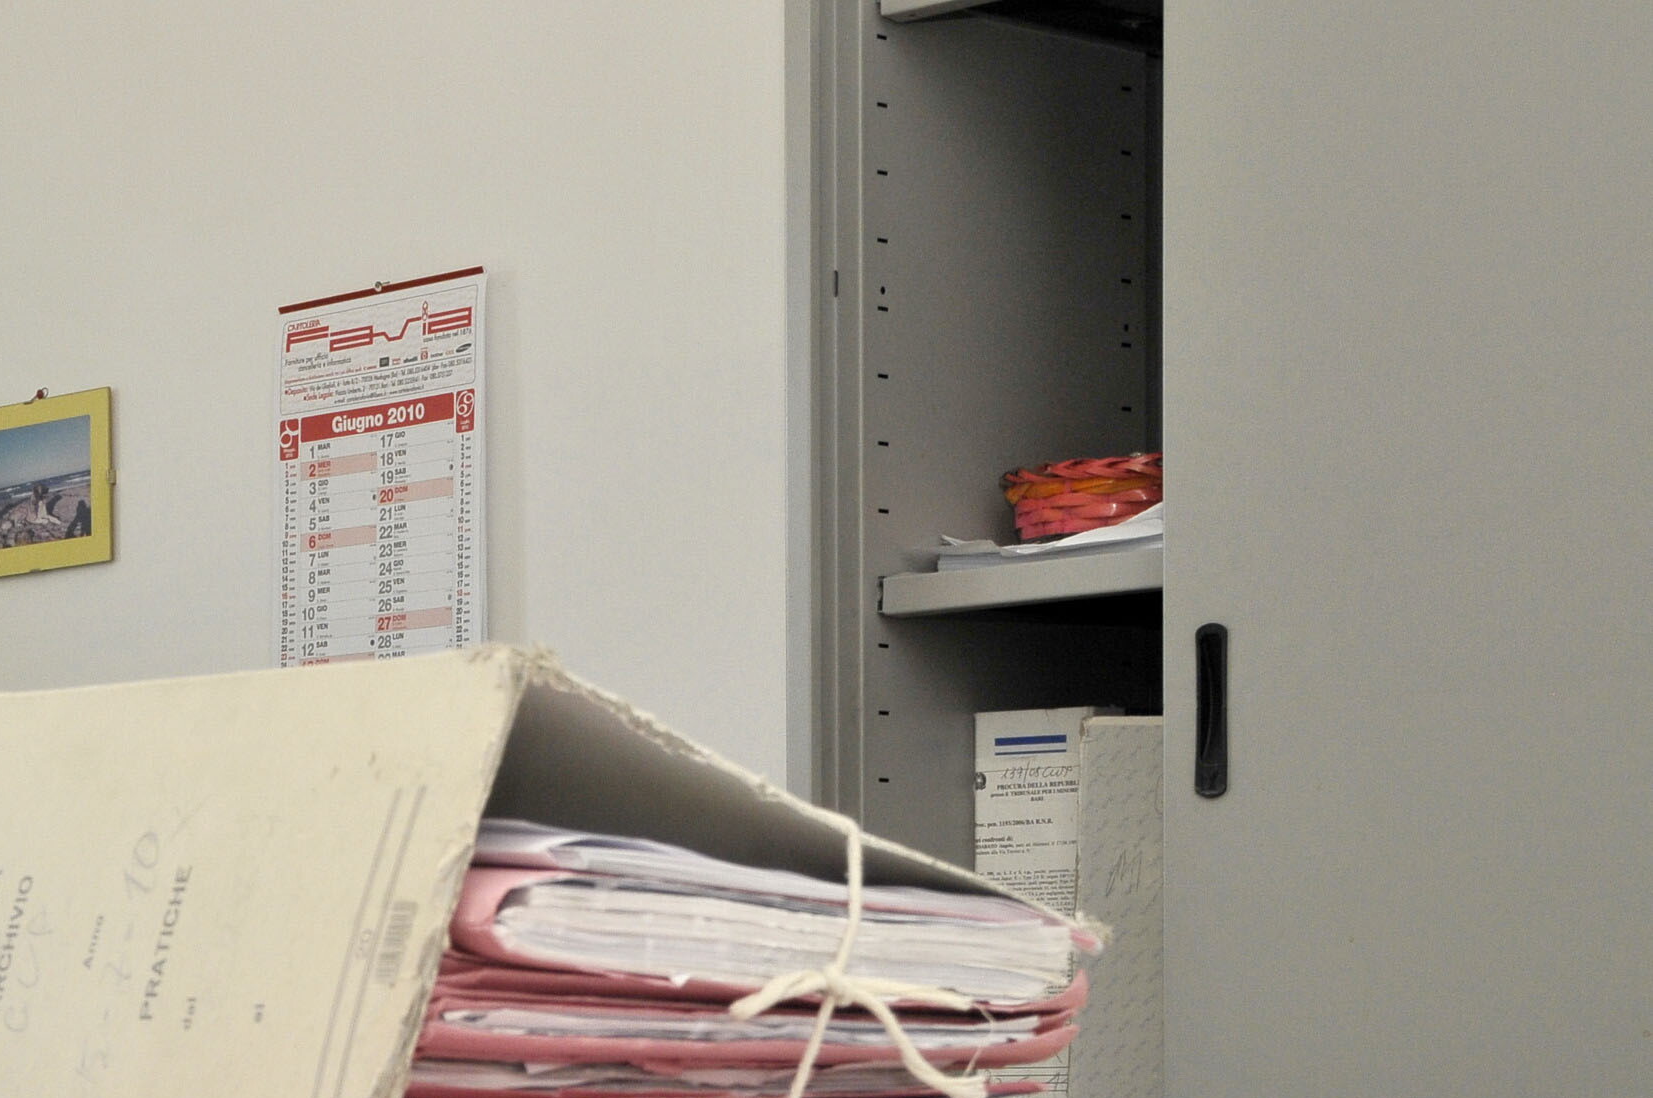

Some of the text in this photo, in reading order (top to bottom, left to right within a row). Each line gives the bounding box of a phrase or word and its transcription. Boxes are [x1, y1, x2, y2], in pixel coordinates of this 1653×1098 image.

[332, 403, 424, 432] Giugno 2010
[380, 434, 393, 448] 17
[310, 446, 315, 459] 1
[380, 452, 394, 466] 18
[309, 464, 316, 477] 2
[380, 470, 394, 484] 19
[309, 482, 316, 495] 3
[380, 489, 393, 503] 20
[309, 500, 316, 512] 4
[380, 507, 392, 521] 21
[309, 518, 316, 530] 5
[379, 526, 392, 539] 22
[309, 536, 316, 549] 6
[379, 544, 392, 558] 23
[309, 553, 315, 566] 7
[379, 562, 392, 576] 24
[309, 571, 316, 584] 8
[379, 580, 392, 594] 25
[308, 590, 315, 602] 9
[378, 598, 392, 612] 26
[302, 607, 315, 620] 10
[378, 617, 391, 631] 27
[302, 625, 313, 638] 11
[378, 635, 391, 649] 28
[302, 643, 314, 656] 12
[83, 914, 104, 970] Anno
[140, 865, 193, 1020] PRATICHE
